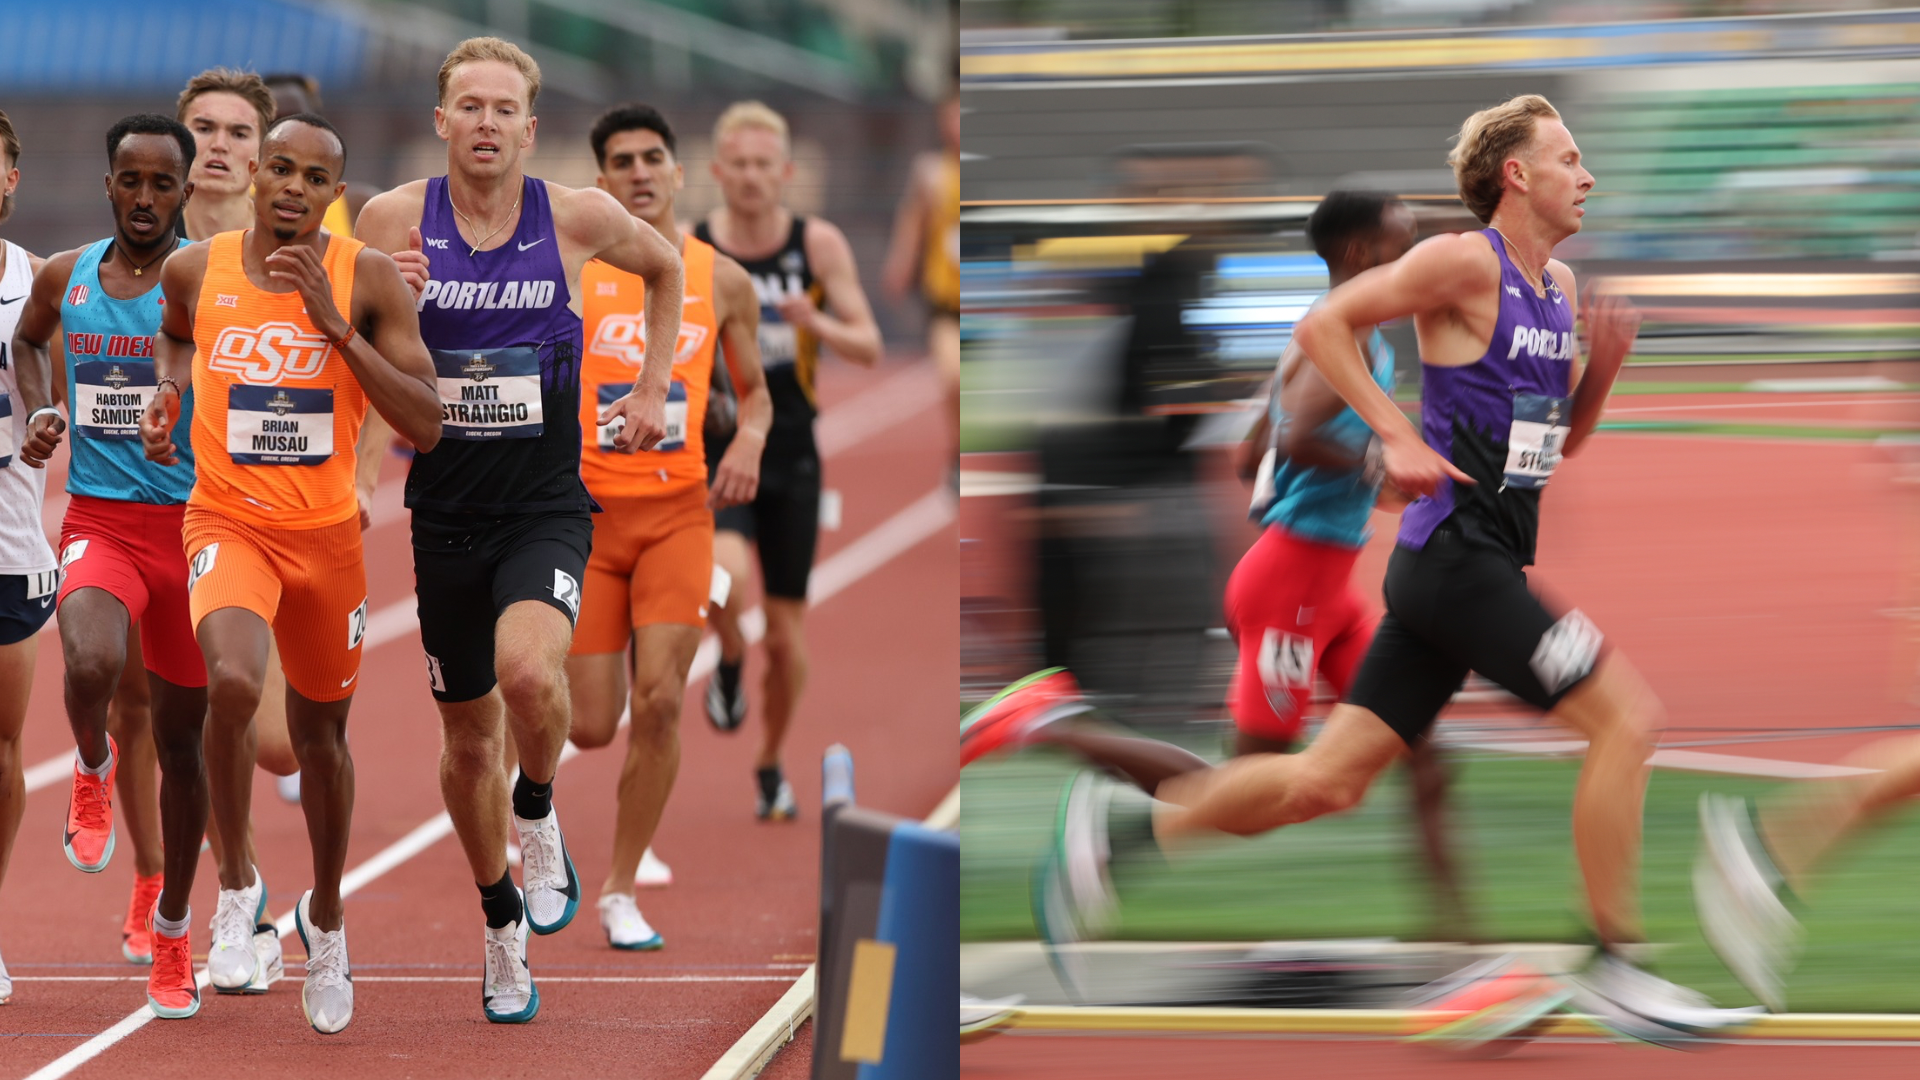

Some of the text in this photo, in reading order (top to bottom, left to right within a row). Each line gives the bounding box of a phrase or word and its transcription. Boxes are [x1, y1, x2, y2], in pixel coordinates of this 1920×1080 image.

[426, 237, 449, 250] WCC
[416, 280, 556, 313] PORTLAND
[67, 332, 104, 356] NEW
[210, 323, 331, 386] OSU
[96, 393, 142, 406] HABTOM
[461, 385, 499, 401] MATT
[442, 402, 529, 424] STRANGIO
[262, 420, 299, 433] BRIAN
[252, 434, 309, 452] MUSAU
[561, 574, 580, 619] 23
